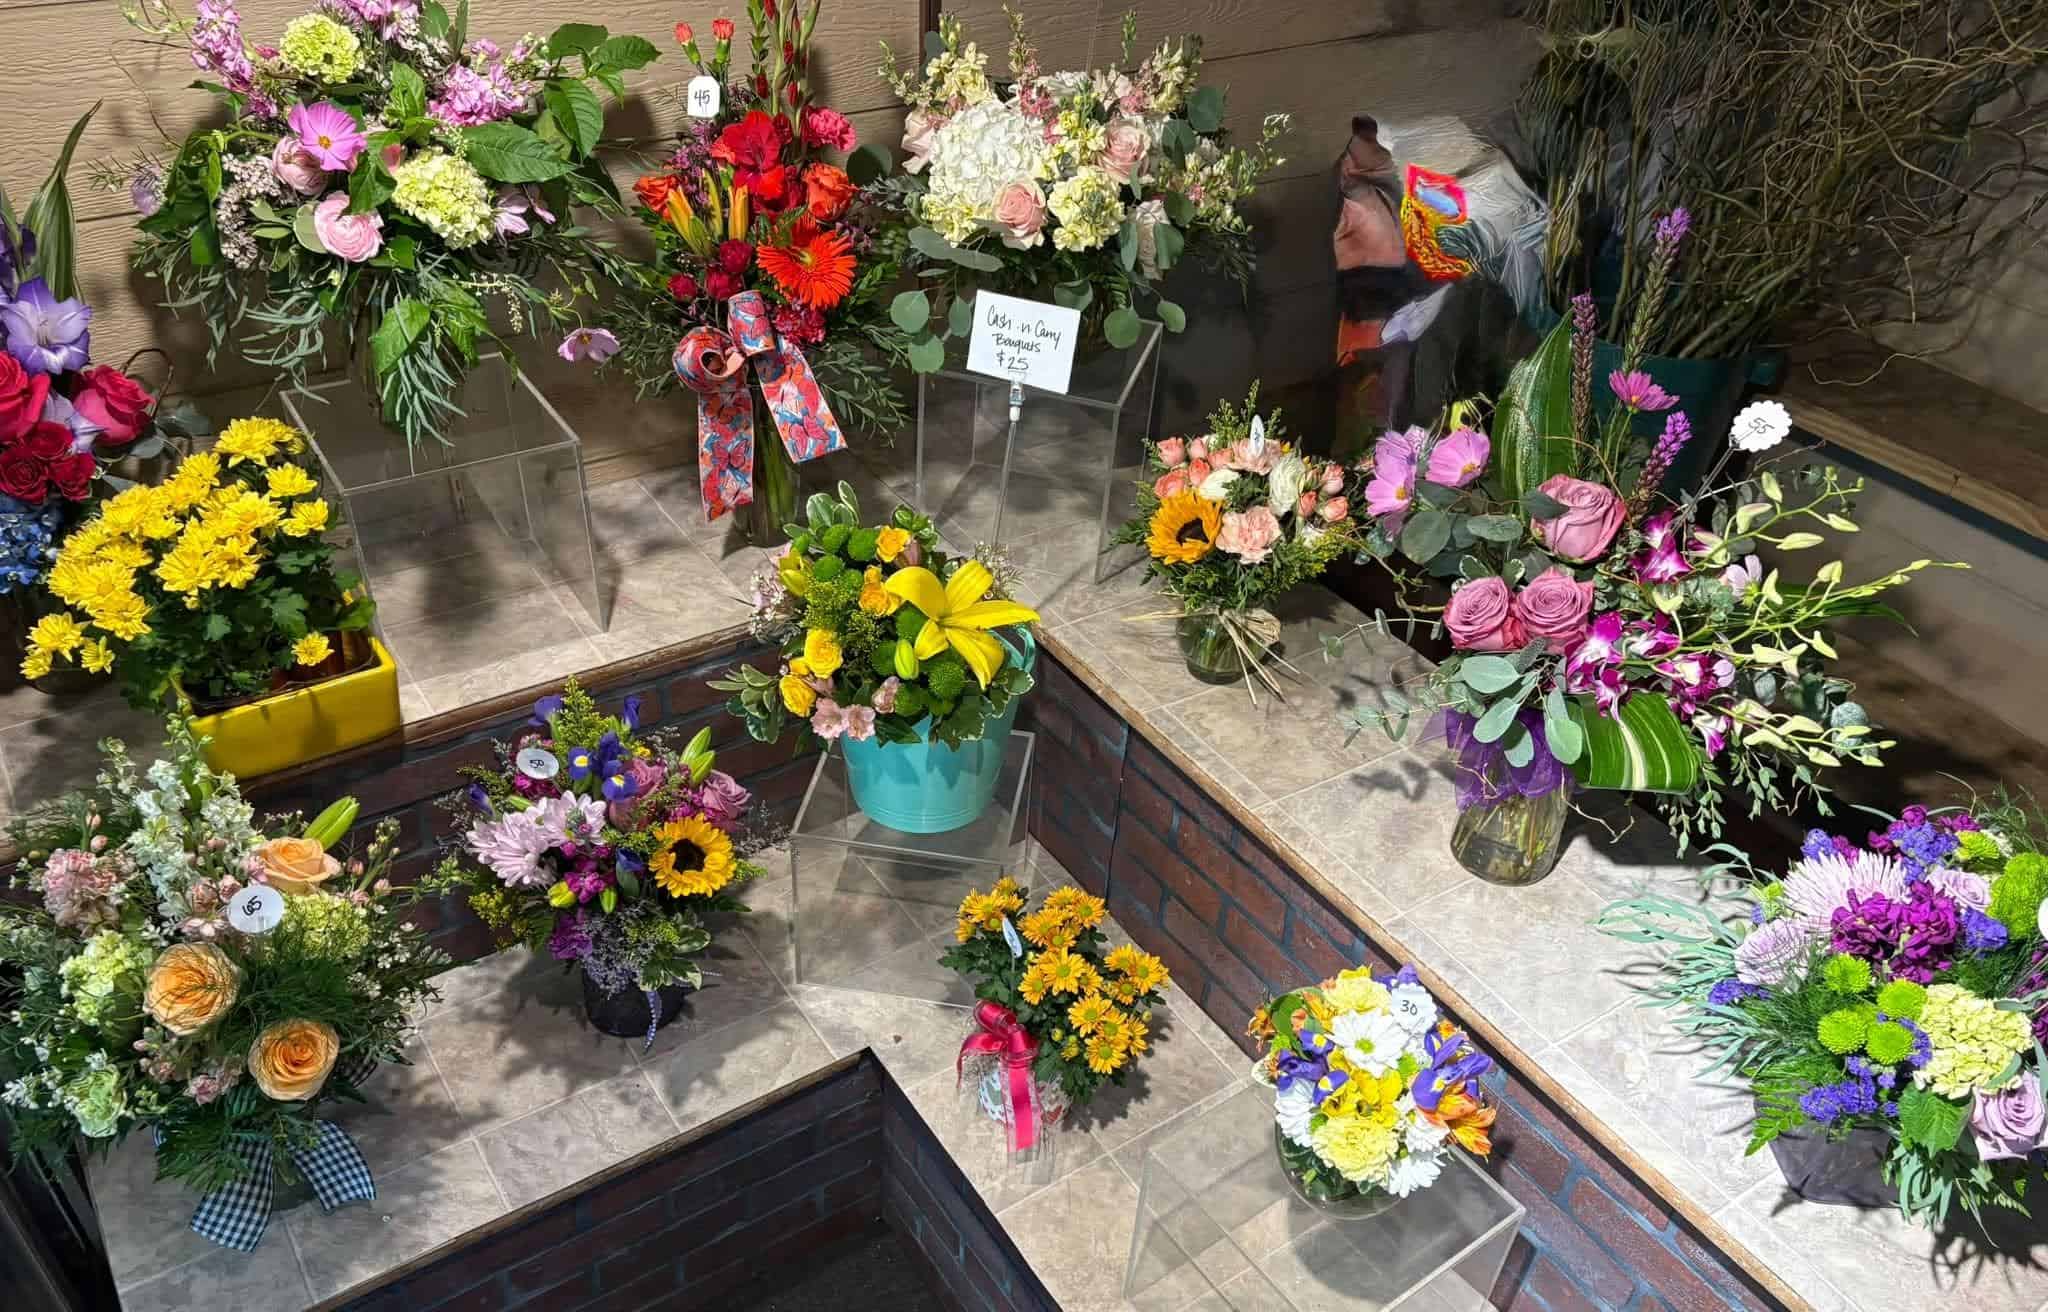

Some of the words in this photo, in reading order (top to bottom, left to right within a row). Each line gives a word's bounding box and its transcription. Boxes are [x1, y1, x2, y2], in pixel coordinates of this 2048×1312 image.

[694, 89, 711, 107] 45
[987, 304, 1011, 329] Cash
[1034, 319, 1062, 351] Carry
[992, 332, 1041, 355] Bouquets
[996, 349, 1029, 371] $25
[1748, 417, 1776, 434] 55
[242, 895, 262, 916] 65
[1400, 999, 1418, 1016] 30
